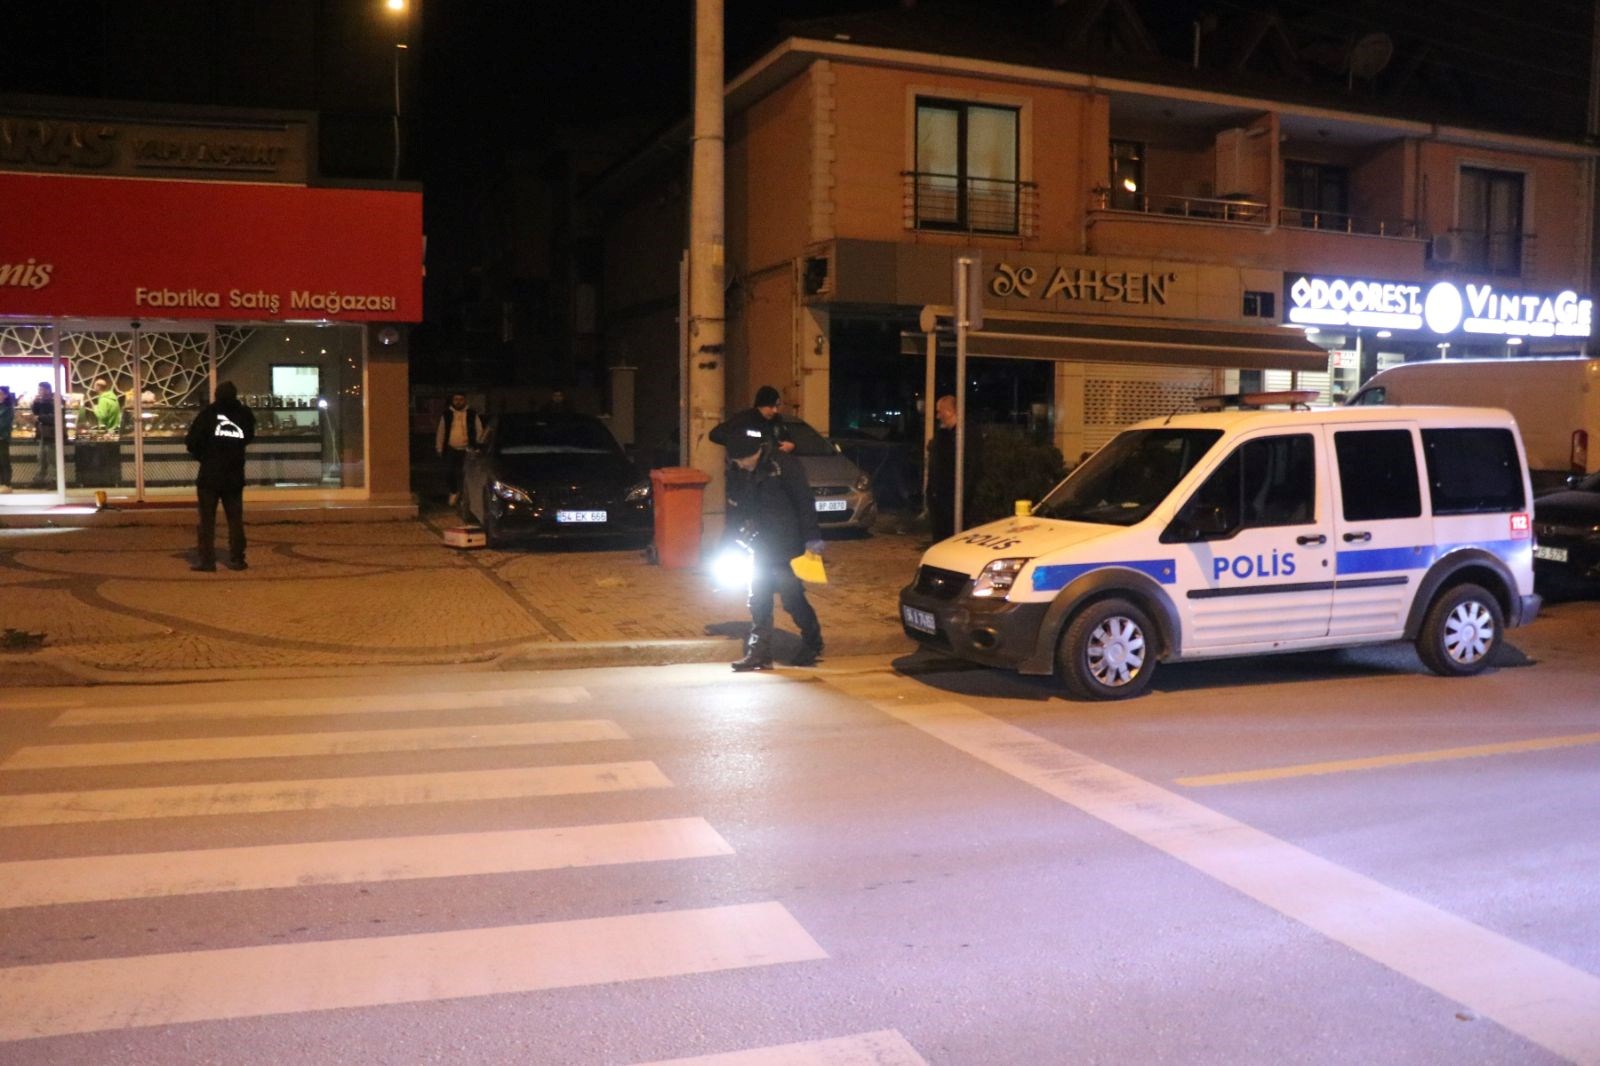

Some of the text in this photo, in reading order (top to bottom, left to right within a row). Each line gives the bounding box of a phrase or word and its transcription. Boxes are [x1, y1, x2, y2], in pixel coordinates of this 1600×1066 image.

[1044, 266, 1168, 304] AHSEN
[136, 287, 396, 313] Fabrika Satış Mağazası
[575, 512, 587, 521] EK
[1511, 516, 1528, 530] 112
[1213, 549, 1296, 579] POLİS
